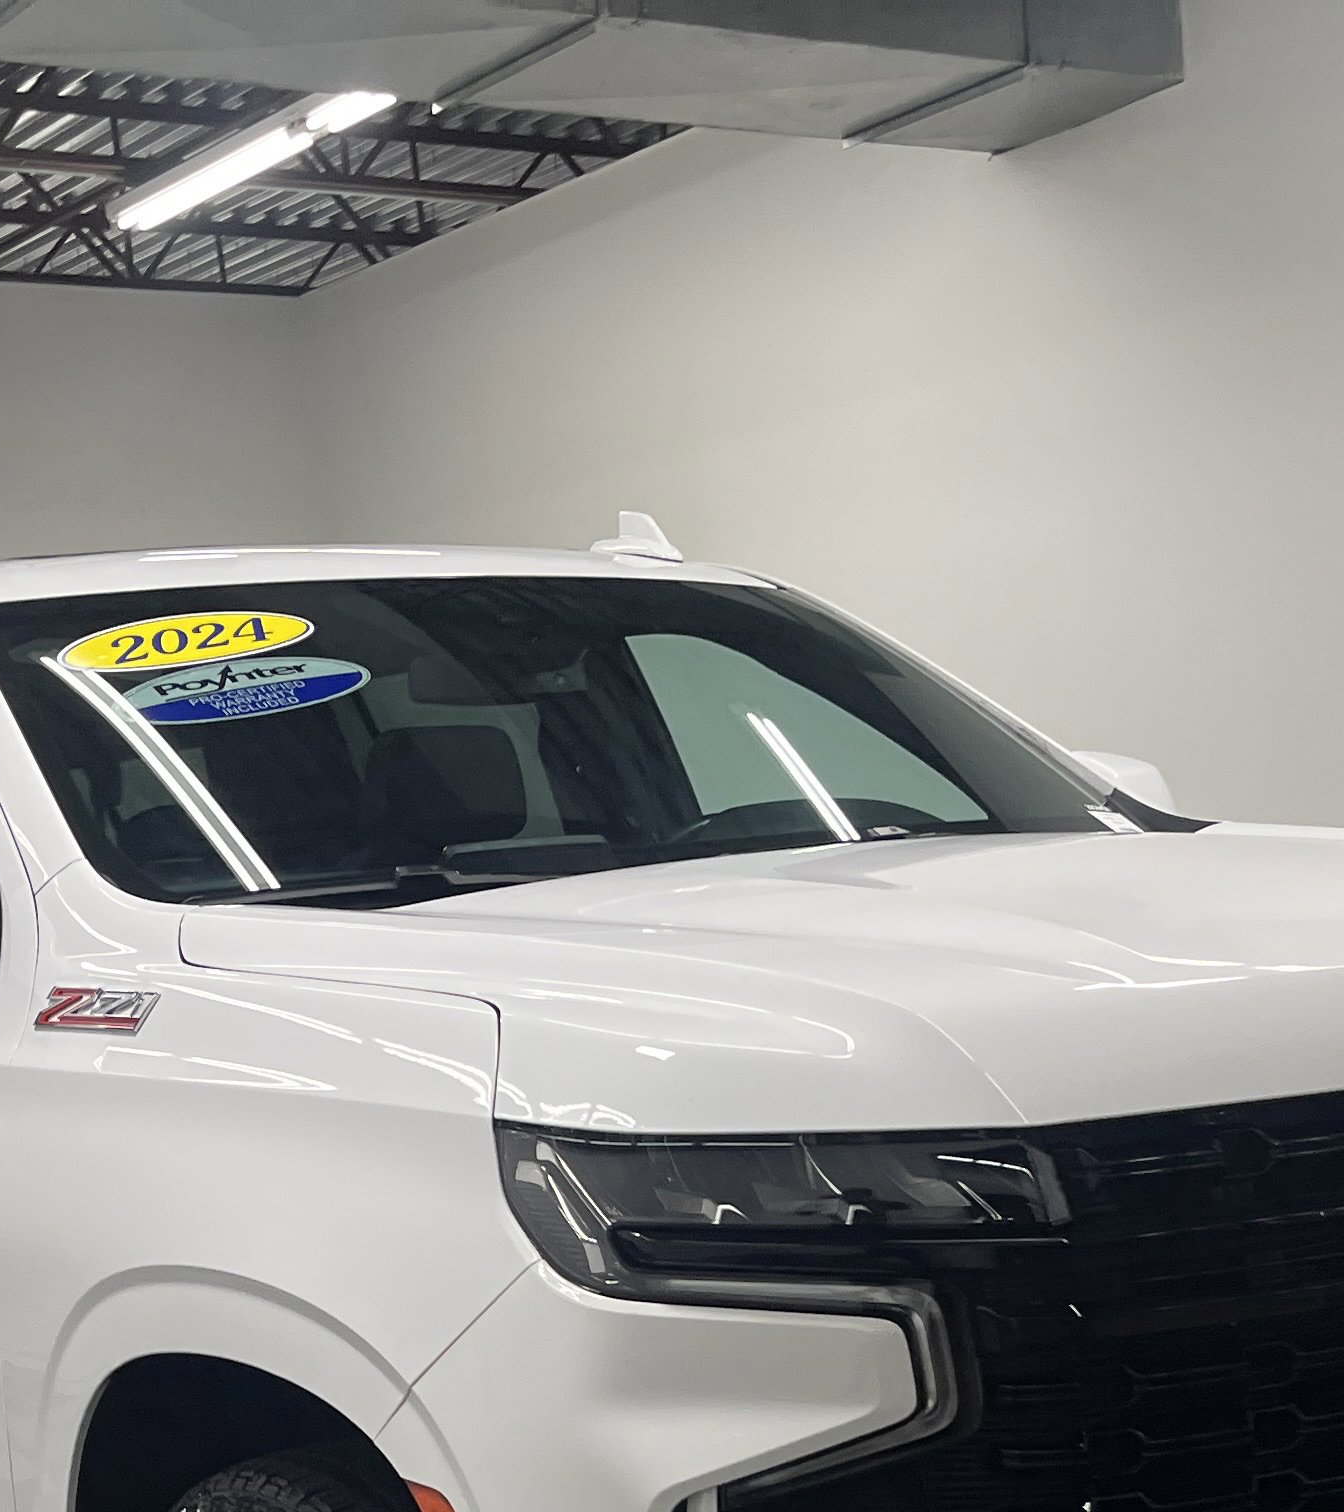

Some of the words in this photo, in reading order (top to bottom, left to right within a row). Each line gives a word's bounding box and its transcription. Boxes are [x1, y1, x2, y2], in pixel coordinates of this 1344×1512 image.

[110, 617, 274, 664] 2024
[153, 664, 307, 696] Poynter
[210, 690, 297, 710] WARRANTY
[221, 697, 300, 716] INCLUDED
[33, 986, 161, 1036] Z71
